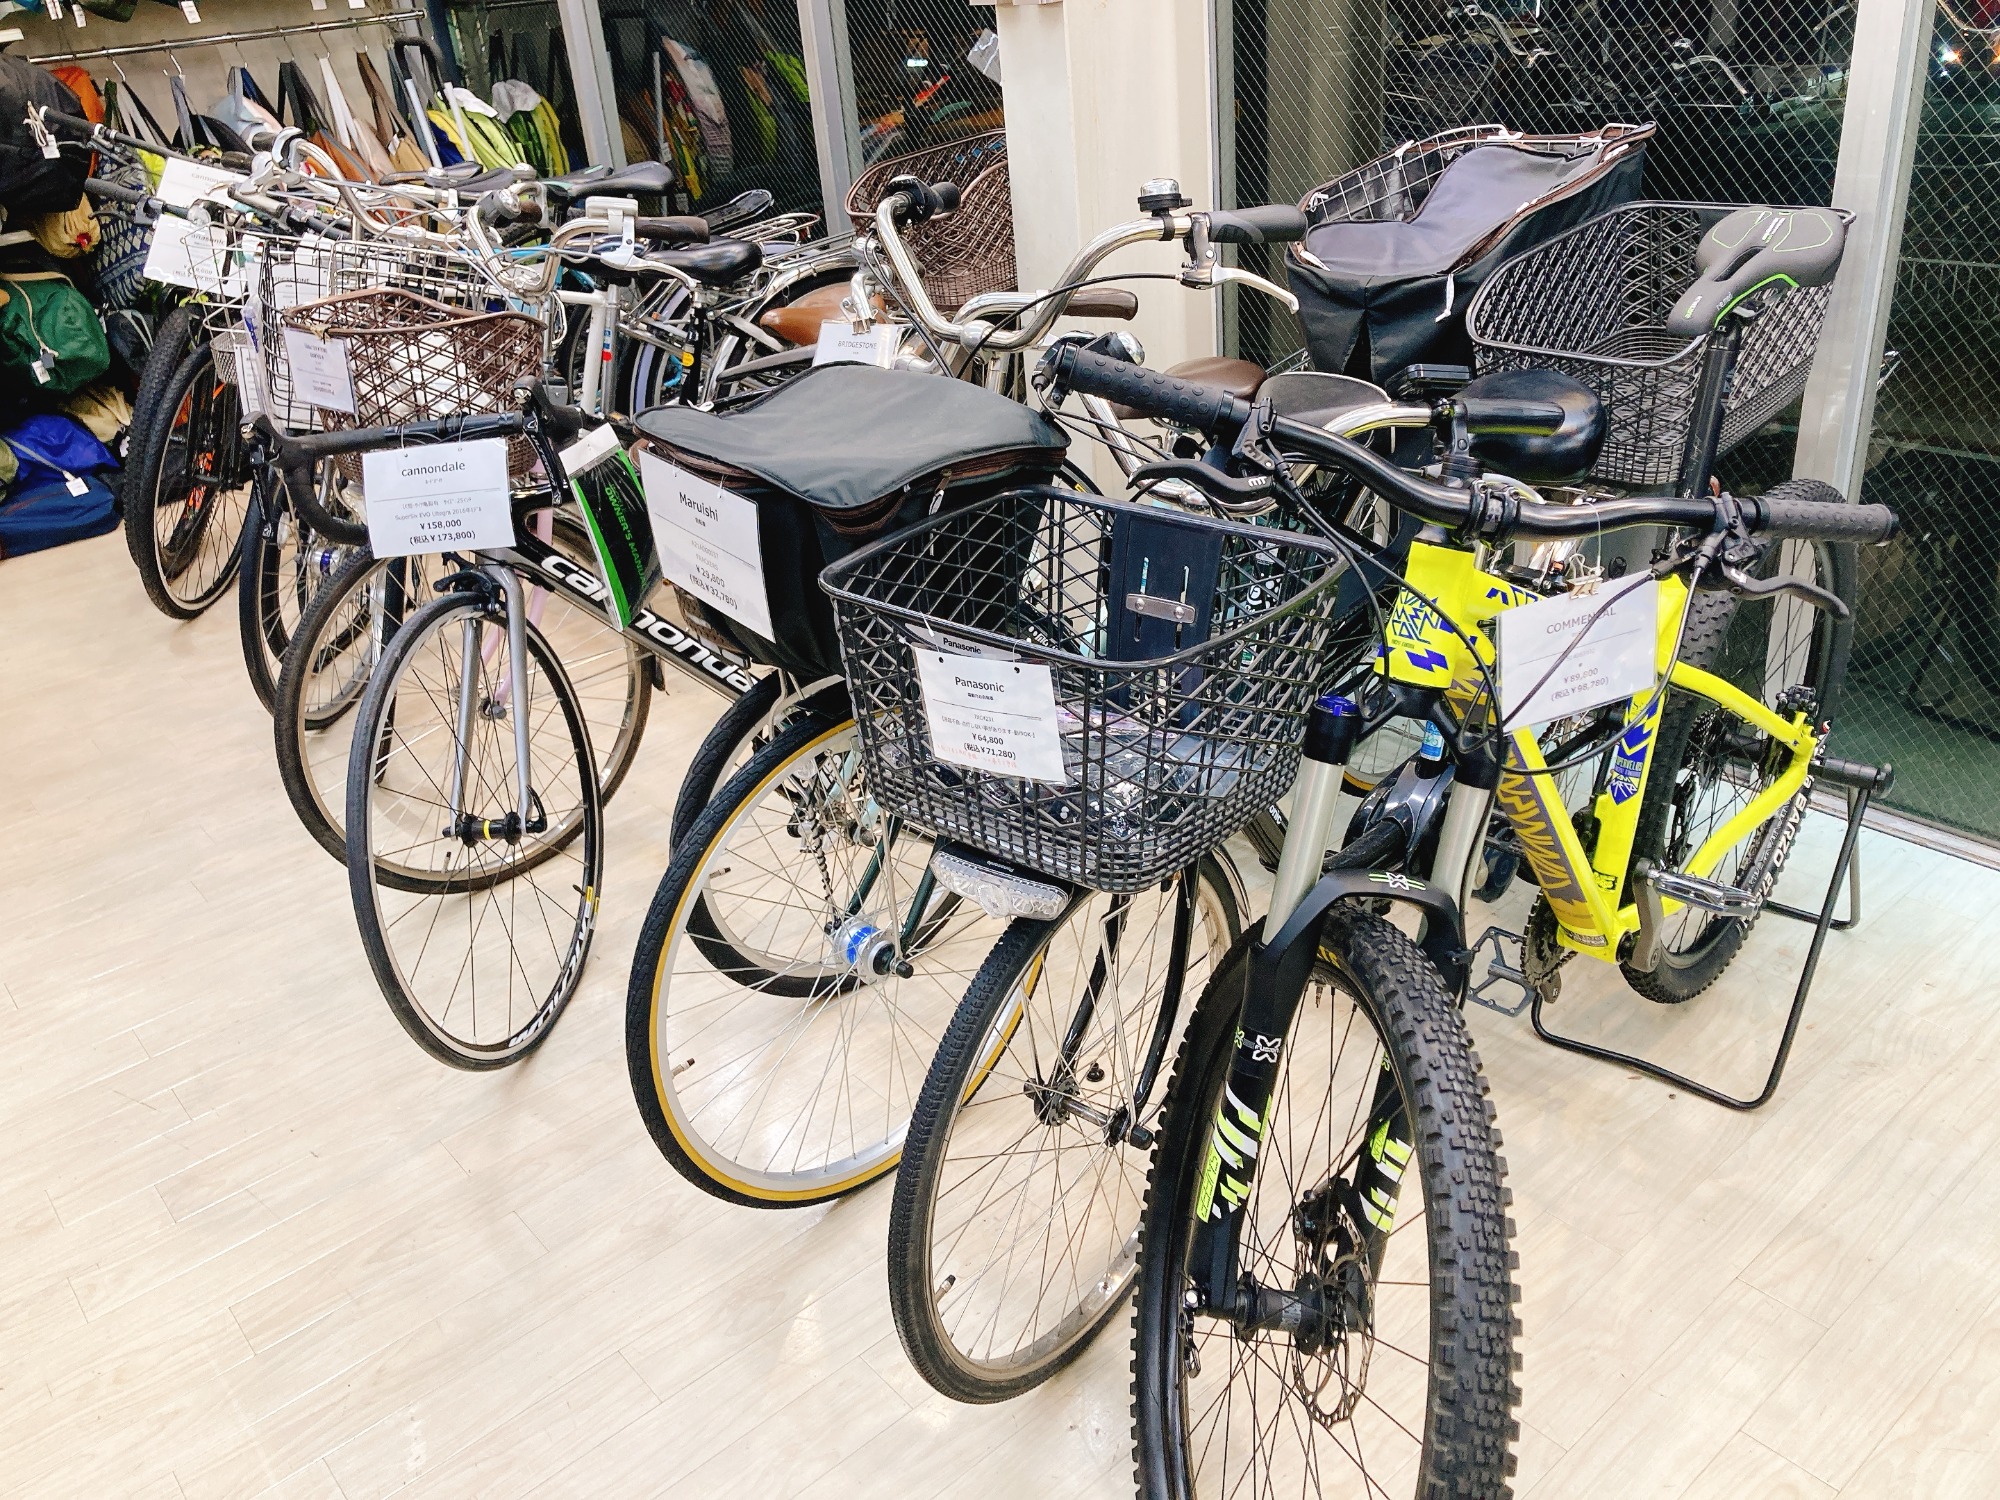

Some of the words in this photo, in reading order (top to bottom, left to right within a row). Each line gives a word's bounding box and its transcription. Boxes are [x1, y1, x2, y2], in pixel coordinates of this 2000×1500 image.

[837, 341, 877, 349] BRIDGESTONE
[401, 461, 466, 477] cannondale
[679, 491, 719, 522] Maruishi
[943, 637, 982, 654] Panasonic
[955, 676, 1005, 693] Panasonic
[972, 732, 1004, 745] ¥64,800
[1773, 792, 1807, 868] BARZO
